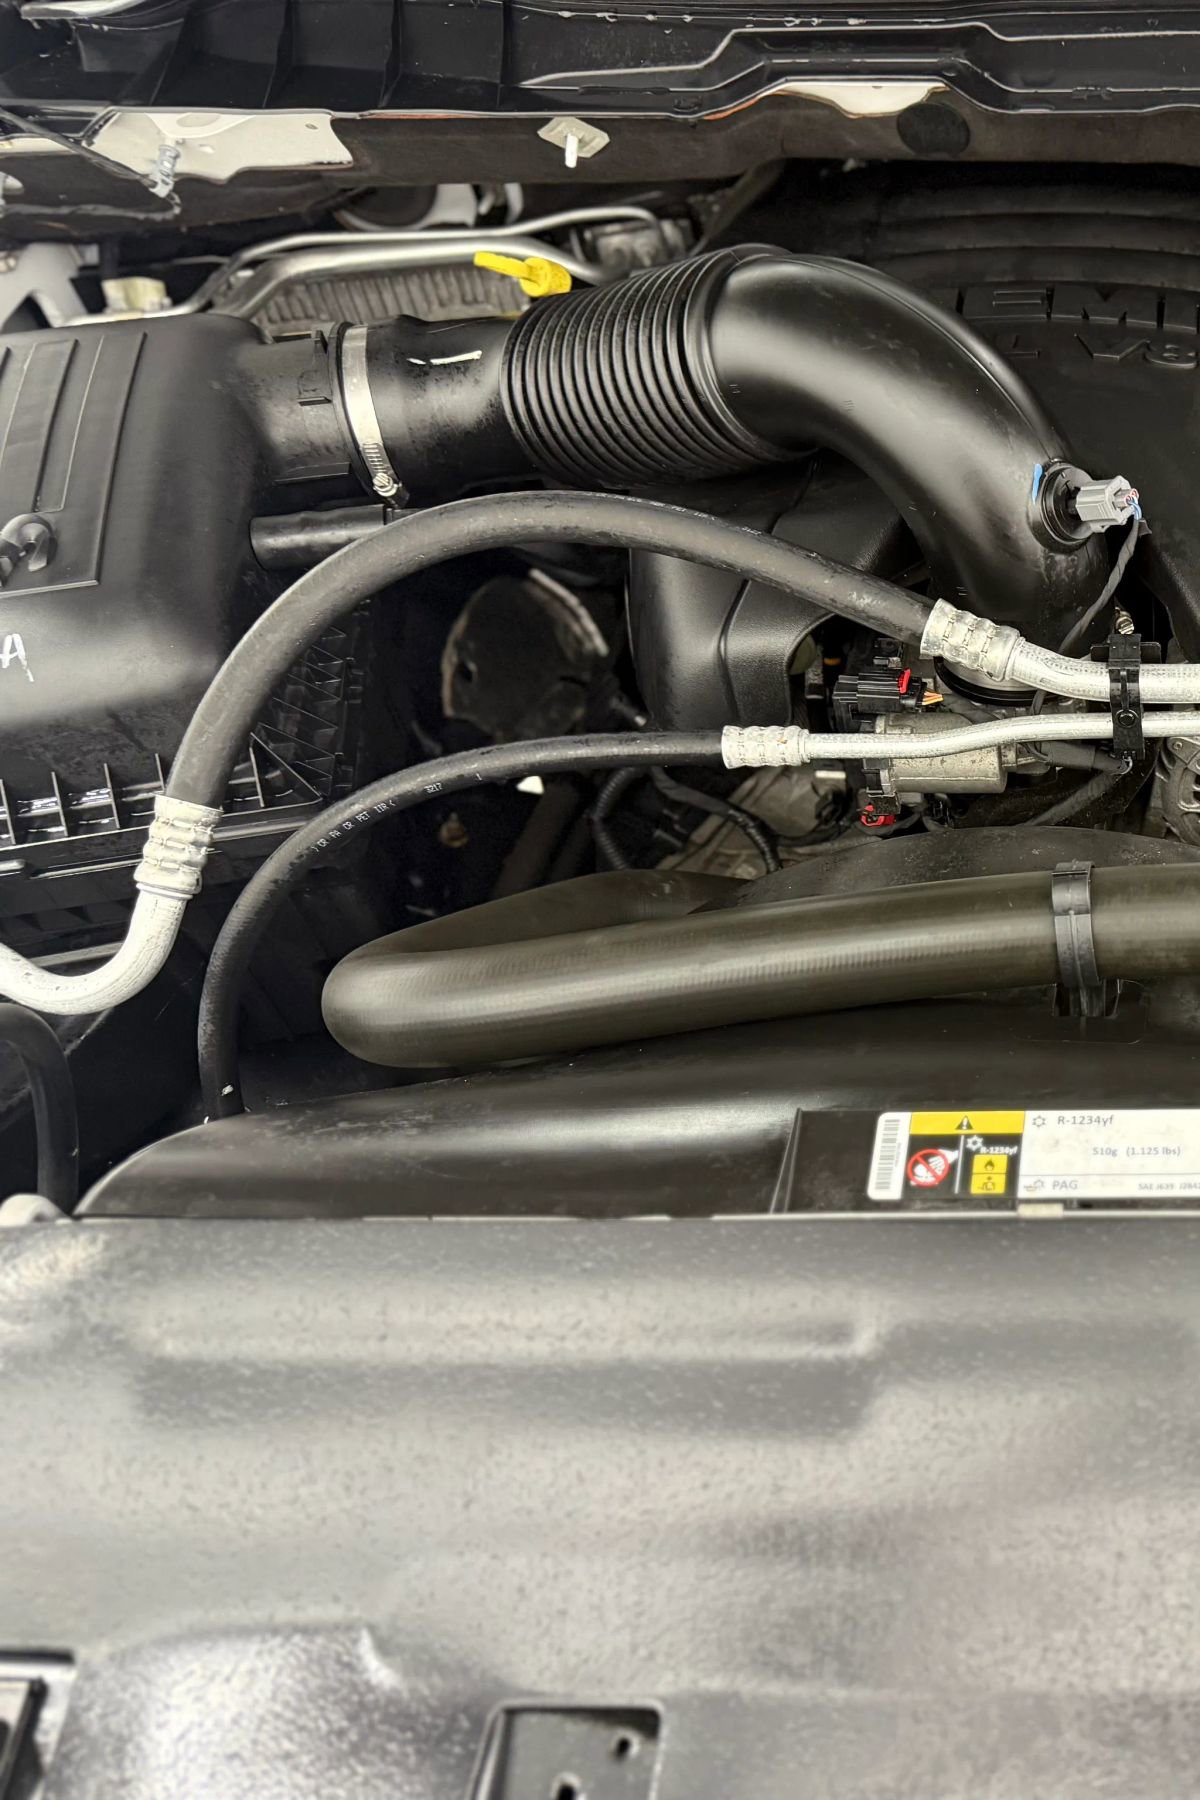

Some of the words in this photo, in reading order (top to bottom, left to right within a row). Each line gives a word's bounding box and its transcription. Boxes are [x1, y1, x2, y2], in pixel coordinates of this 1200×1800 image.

[355, 811, 371, 823] PET
[1057, 1115, 1114, 1127] R-1234yf
[1092, 1147, 1118, 1157] 510g
[1126, 1146, 1159, 1157] (1.125
[1161, 1146, 1181, 1157] lbs)
[1052, 1180, 1079, 1191] PAG
[1138, 1183, 1154, 1191] SAE
